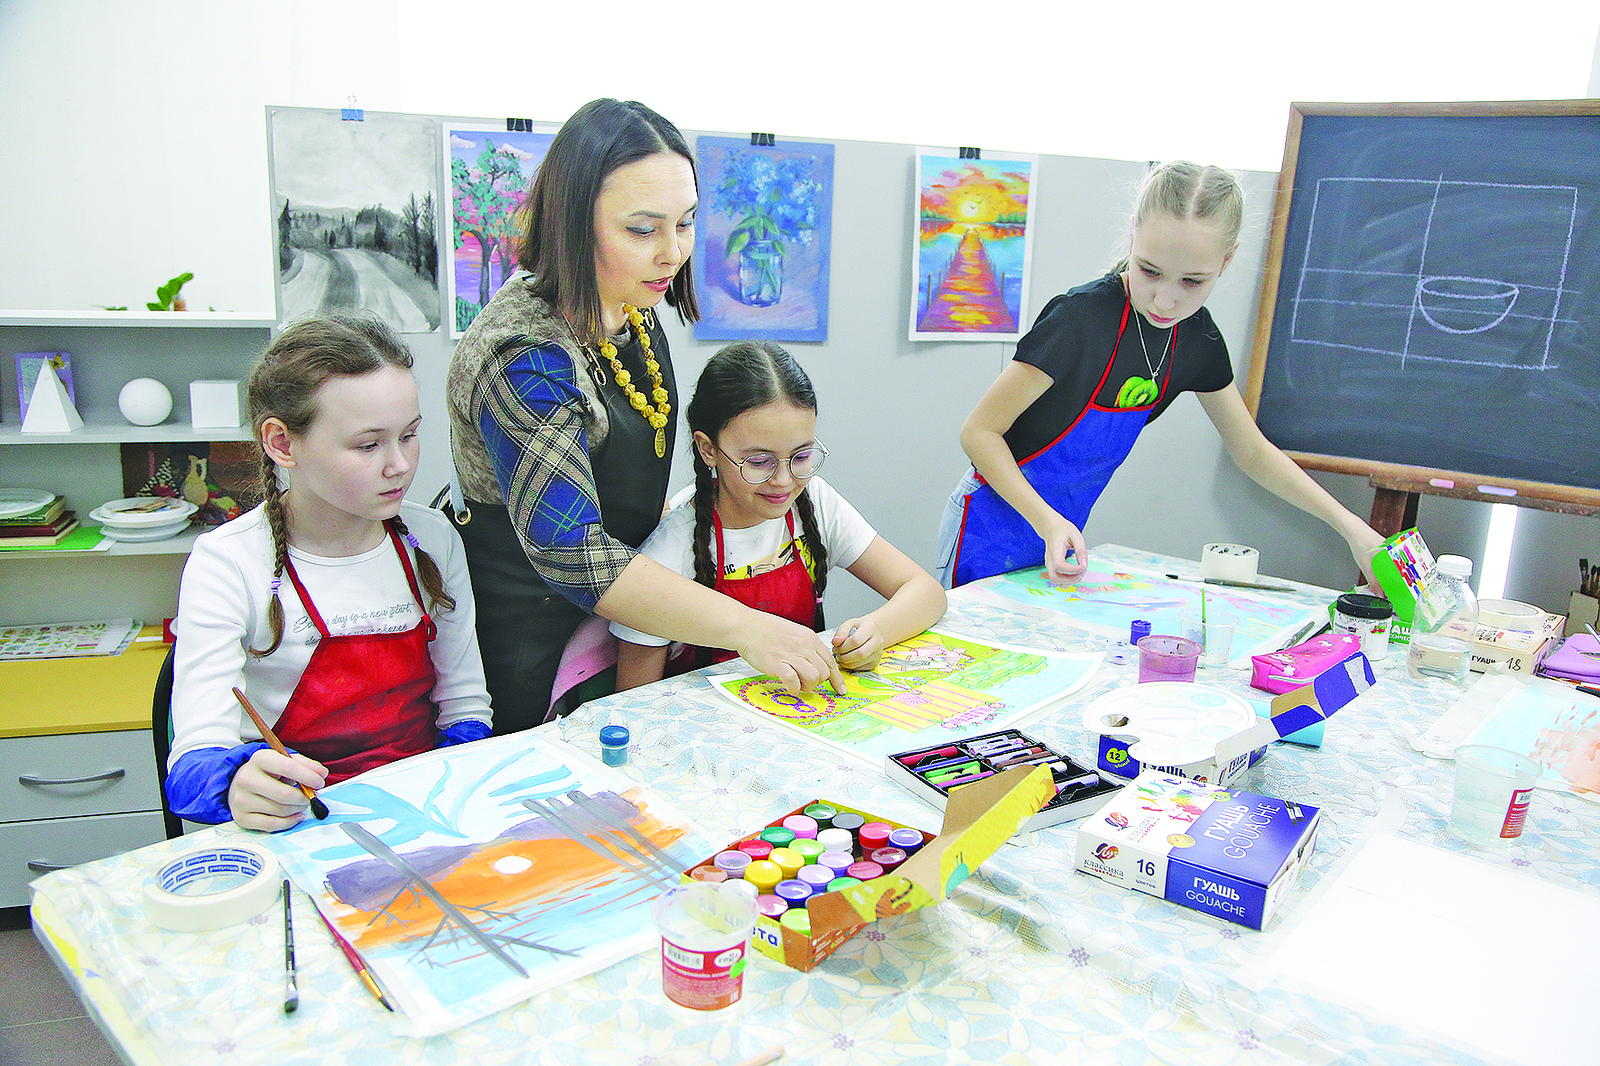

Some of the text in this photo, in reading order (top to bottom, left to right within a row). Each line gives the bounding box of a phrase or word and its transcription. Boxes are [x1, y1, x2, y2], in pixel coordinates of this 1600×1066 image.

[331, 613, 348, 629] day
[1505, 657, 1521, 671] 18
[1109, 751, 1120, 762] 12
[1203, 804, 1250, 841] ГУАШЬ
[1223, 802, 1281, 859] GOUACHE
[1083, 859, 1124, 877] классика
[1136, 858, 1155, 877] 16
[1193, 877, 1241, 901] ГУАШЬ
[1186, 890, 1246, 917] GOUACHE
